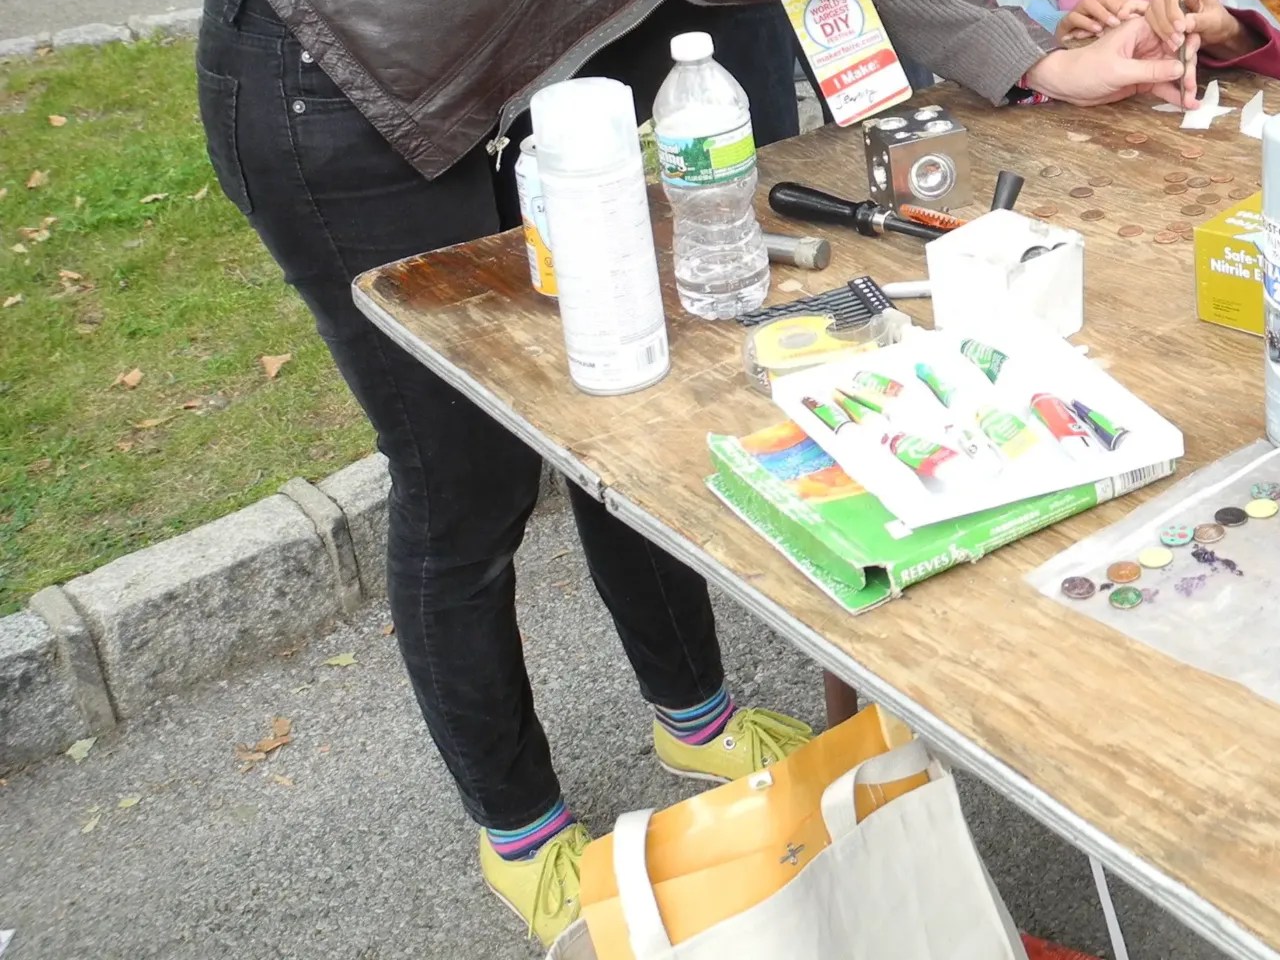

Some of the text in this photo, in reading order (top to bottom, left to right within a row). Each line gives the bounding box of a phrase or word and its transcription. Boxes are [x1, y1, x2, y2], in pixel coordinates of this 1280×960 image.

[814, 5, 850, 25] LARGEST
[820, 13, 850, 38] DIY
[816, 33, 881, 64] makerfaire.com
[833, 60, 880, 89] I Make:
[1211, 258, 1250, 278] Nitrile
[1224, 246, 1264, 268] Safe-T
[901, 551, 950, 581] REEVES
